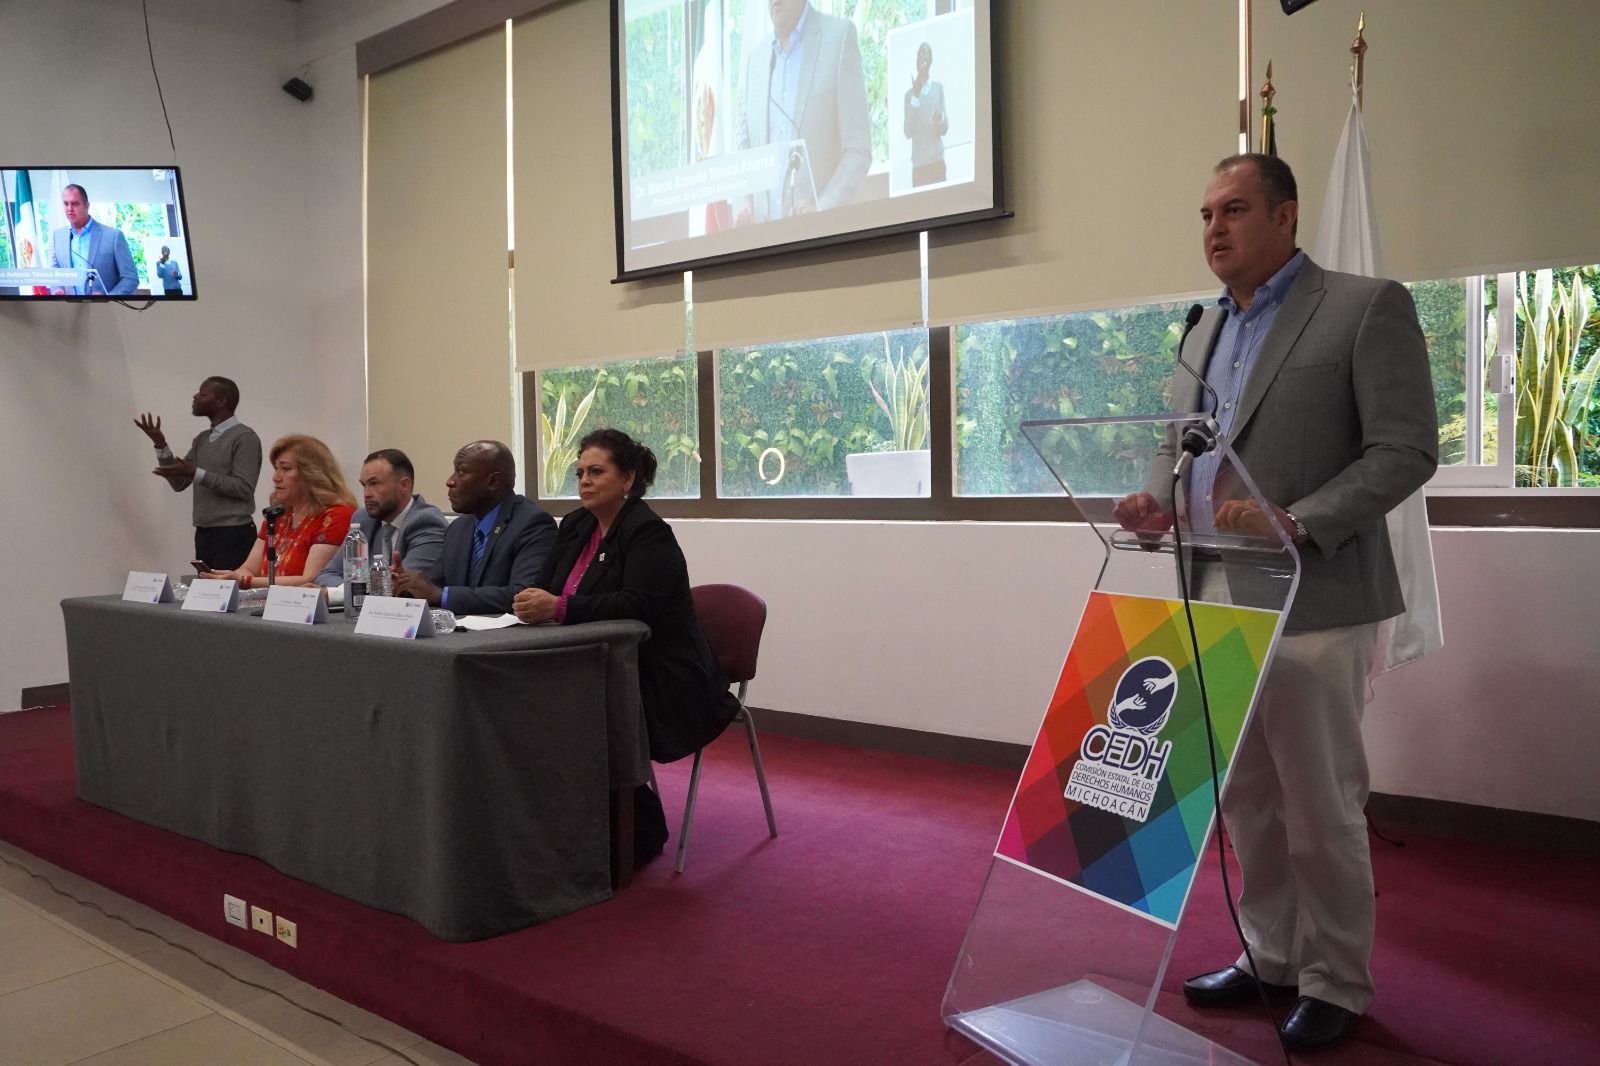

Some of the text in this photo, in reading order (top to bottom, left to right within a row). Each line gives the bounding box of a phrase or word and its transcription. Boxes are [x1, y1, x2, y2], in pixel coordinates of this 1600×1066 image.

[1083, 727, 1169, 779] CEDH
[1072, 771, 1152, 802] DERECHOS HUMANOS
[1076, 763, 1155, 791] COMISIÓN ESTATAL DE LOS
[1066, 785, 1147, 819] MICHOACÁN
